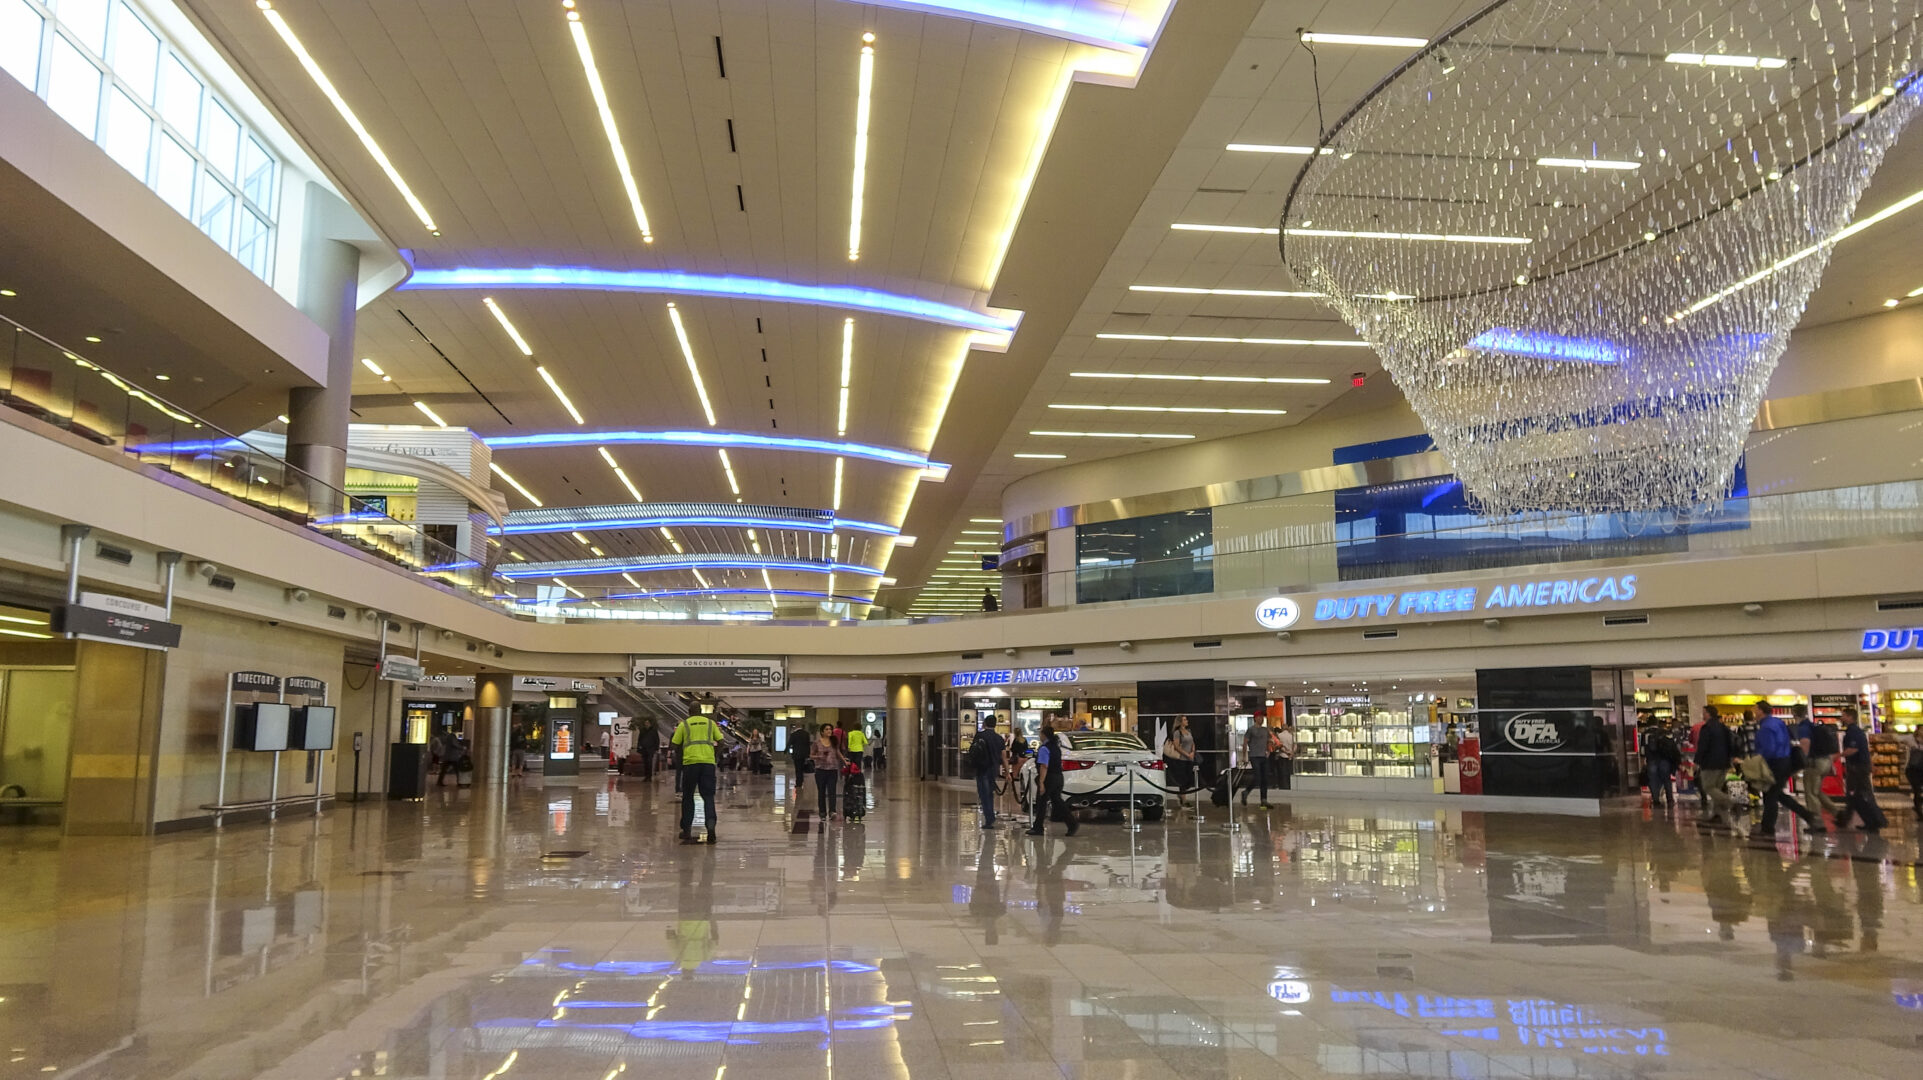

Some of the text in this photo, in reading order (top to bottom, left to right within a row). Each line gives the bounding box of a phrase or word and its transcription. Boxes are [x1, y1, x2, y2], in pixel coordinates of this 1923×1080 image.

[1314, 574, 1637, 621] DUTY FREE AMERICAS
[1262, 606, 1289, 620] DFA
[238, 673, 275, 685] DIRECTORY
[289, 678, 321, 688] DIRECTORY
[952, 667, 1080, 686] DUTY FREE AMERICAS
[1514, 723, 1559, 744] DFA
